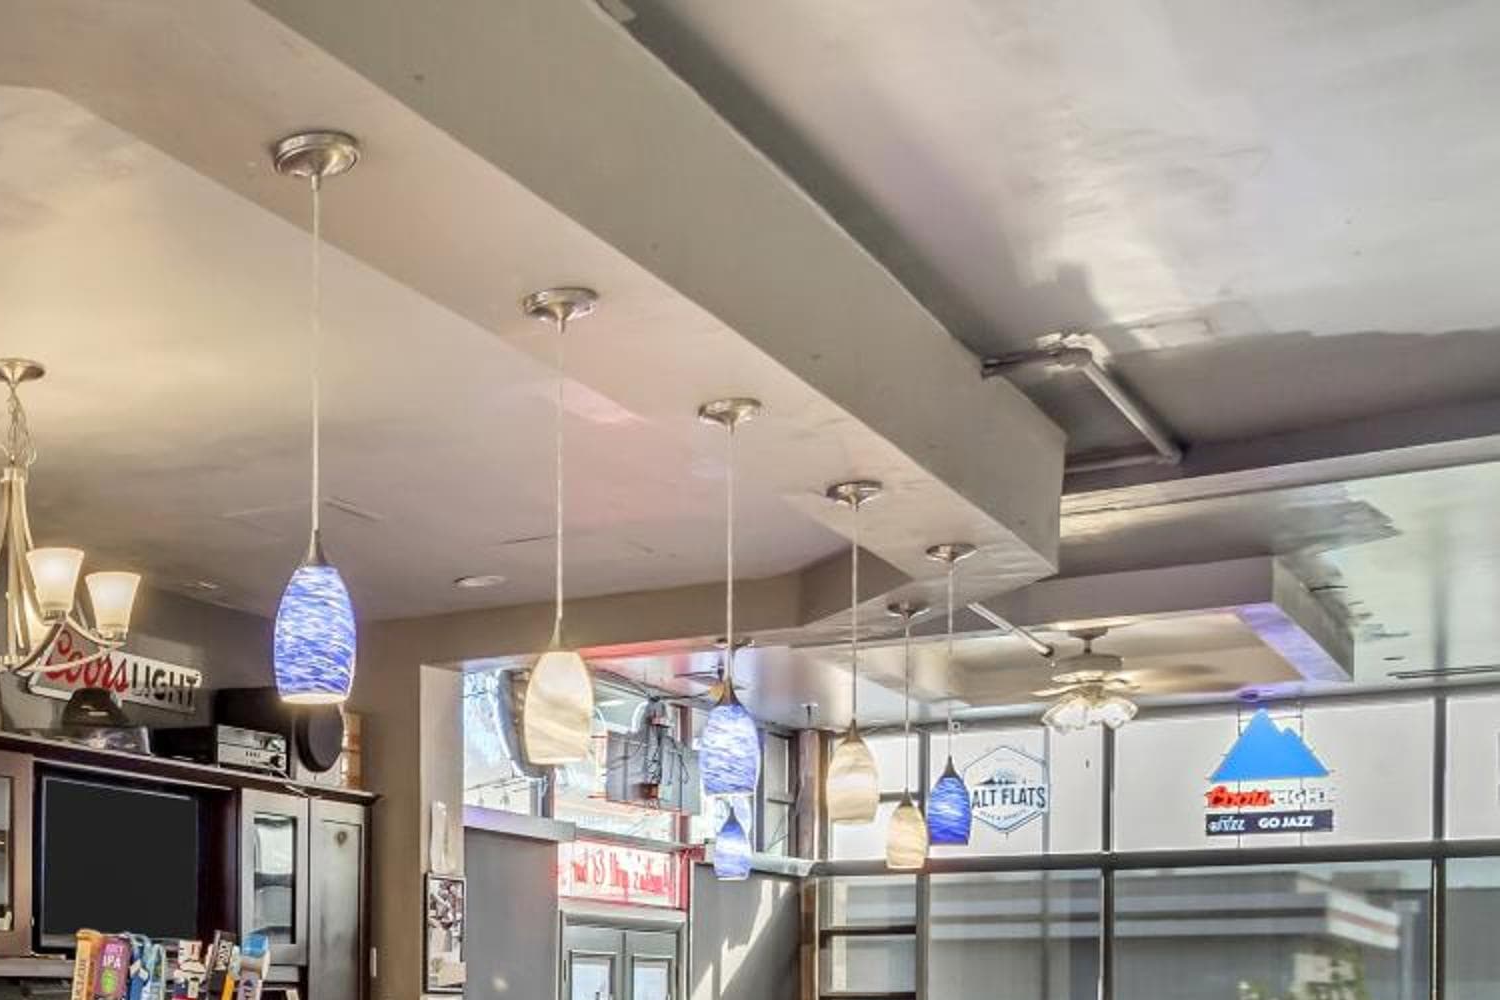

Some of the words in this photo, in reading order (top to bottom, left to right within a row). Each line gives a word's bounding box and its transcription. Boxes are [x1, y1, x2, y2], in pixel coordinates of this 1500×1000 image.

[44, 629, 130, 693] Coors
[132, 662, 198, 707] LIGHT
[971, 790, 997, 809] ALT
[1001, 786, 1046, 809] FLATS
[1258, 817, 1281, 829] GO
[1282, 815, 1315, 828] JAZZ
[102, 954, 121, 969] IPA
